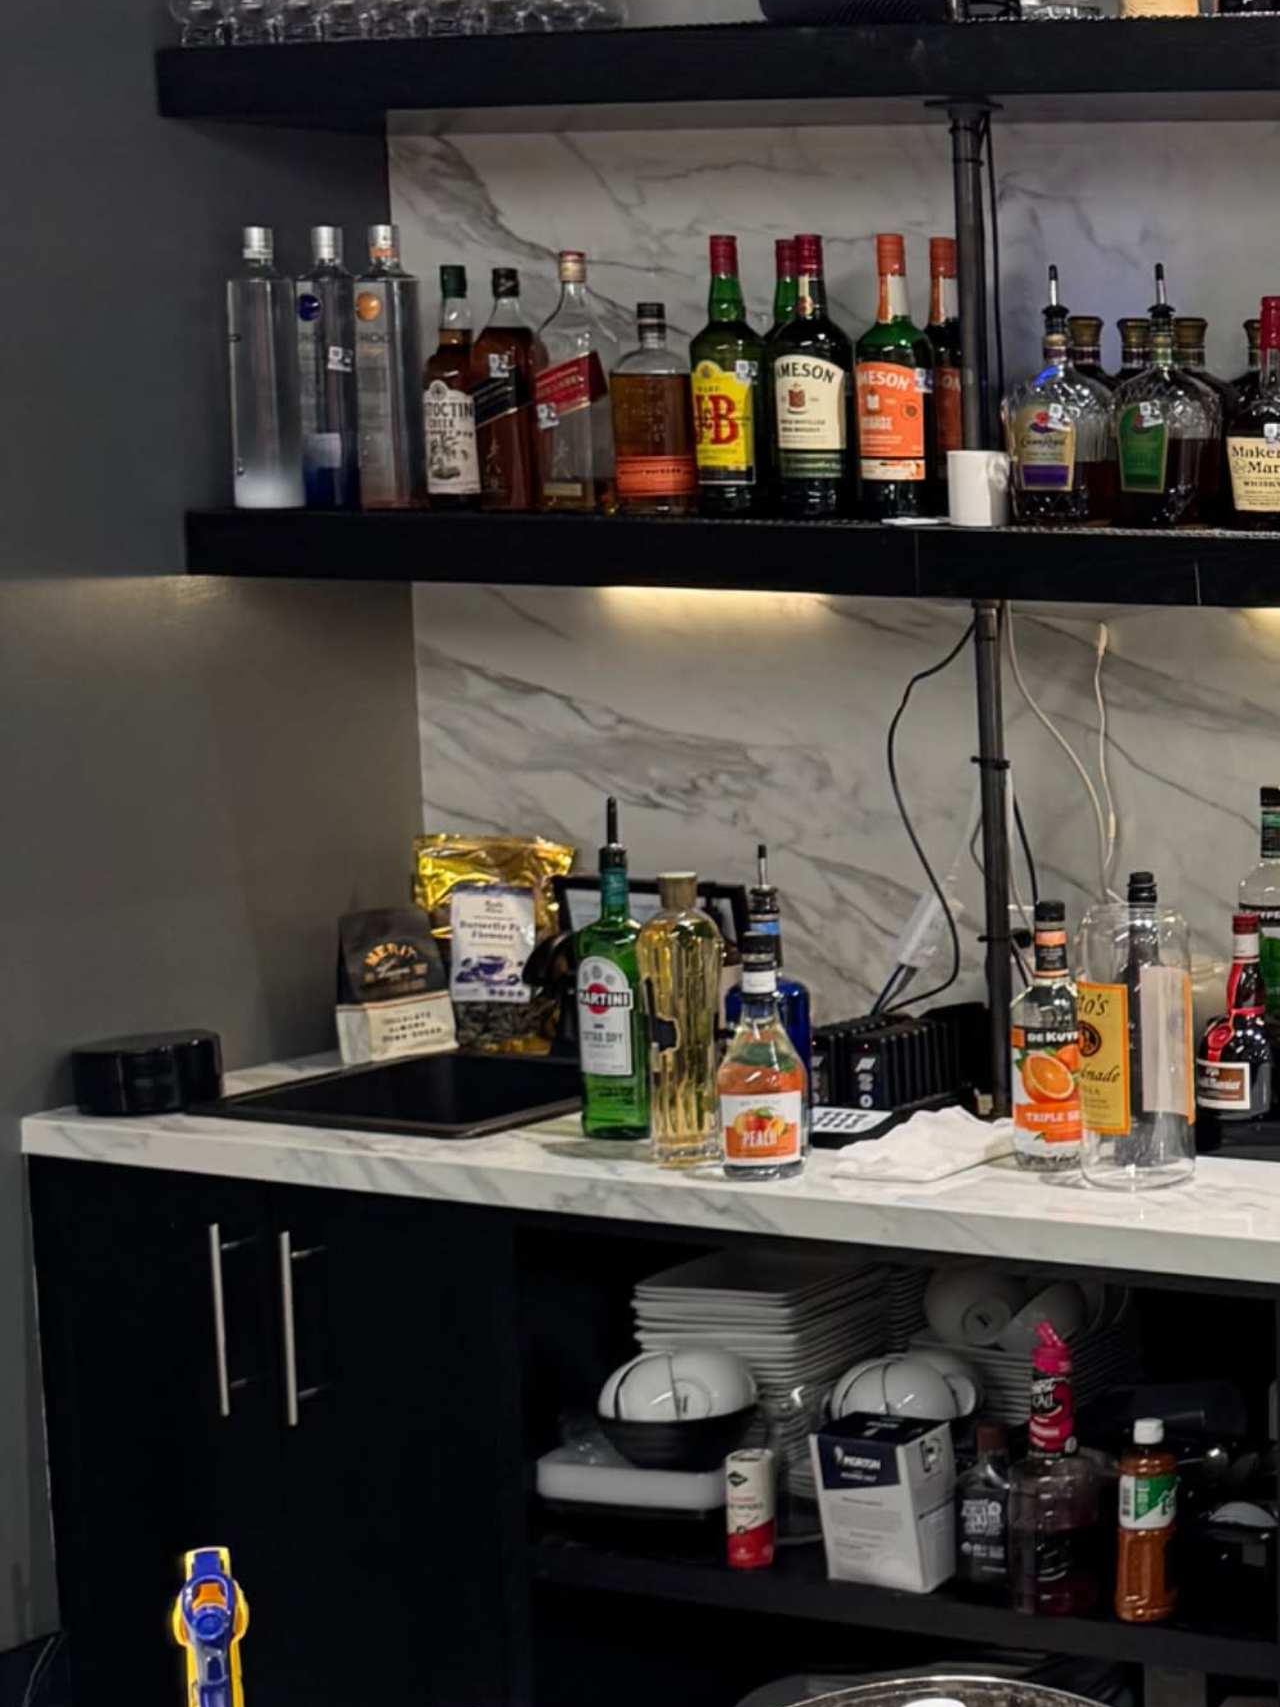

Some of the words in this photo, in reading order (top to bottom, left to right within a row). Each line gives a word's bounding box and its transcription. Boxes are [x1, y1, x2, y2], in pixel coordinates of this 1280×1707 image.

[423, 400, 473, 419] TOCTIN
[1079, 993, 1109, 1016] to's
[1025, 1111, 1065, 1122] TRIPLE
[742, 1132, 778, 1148] PEACH
